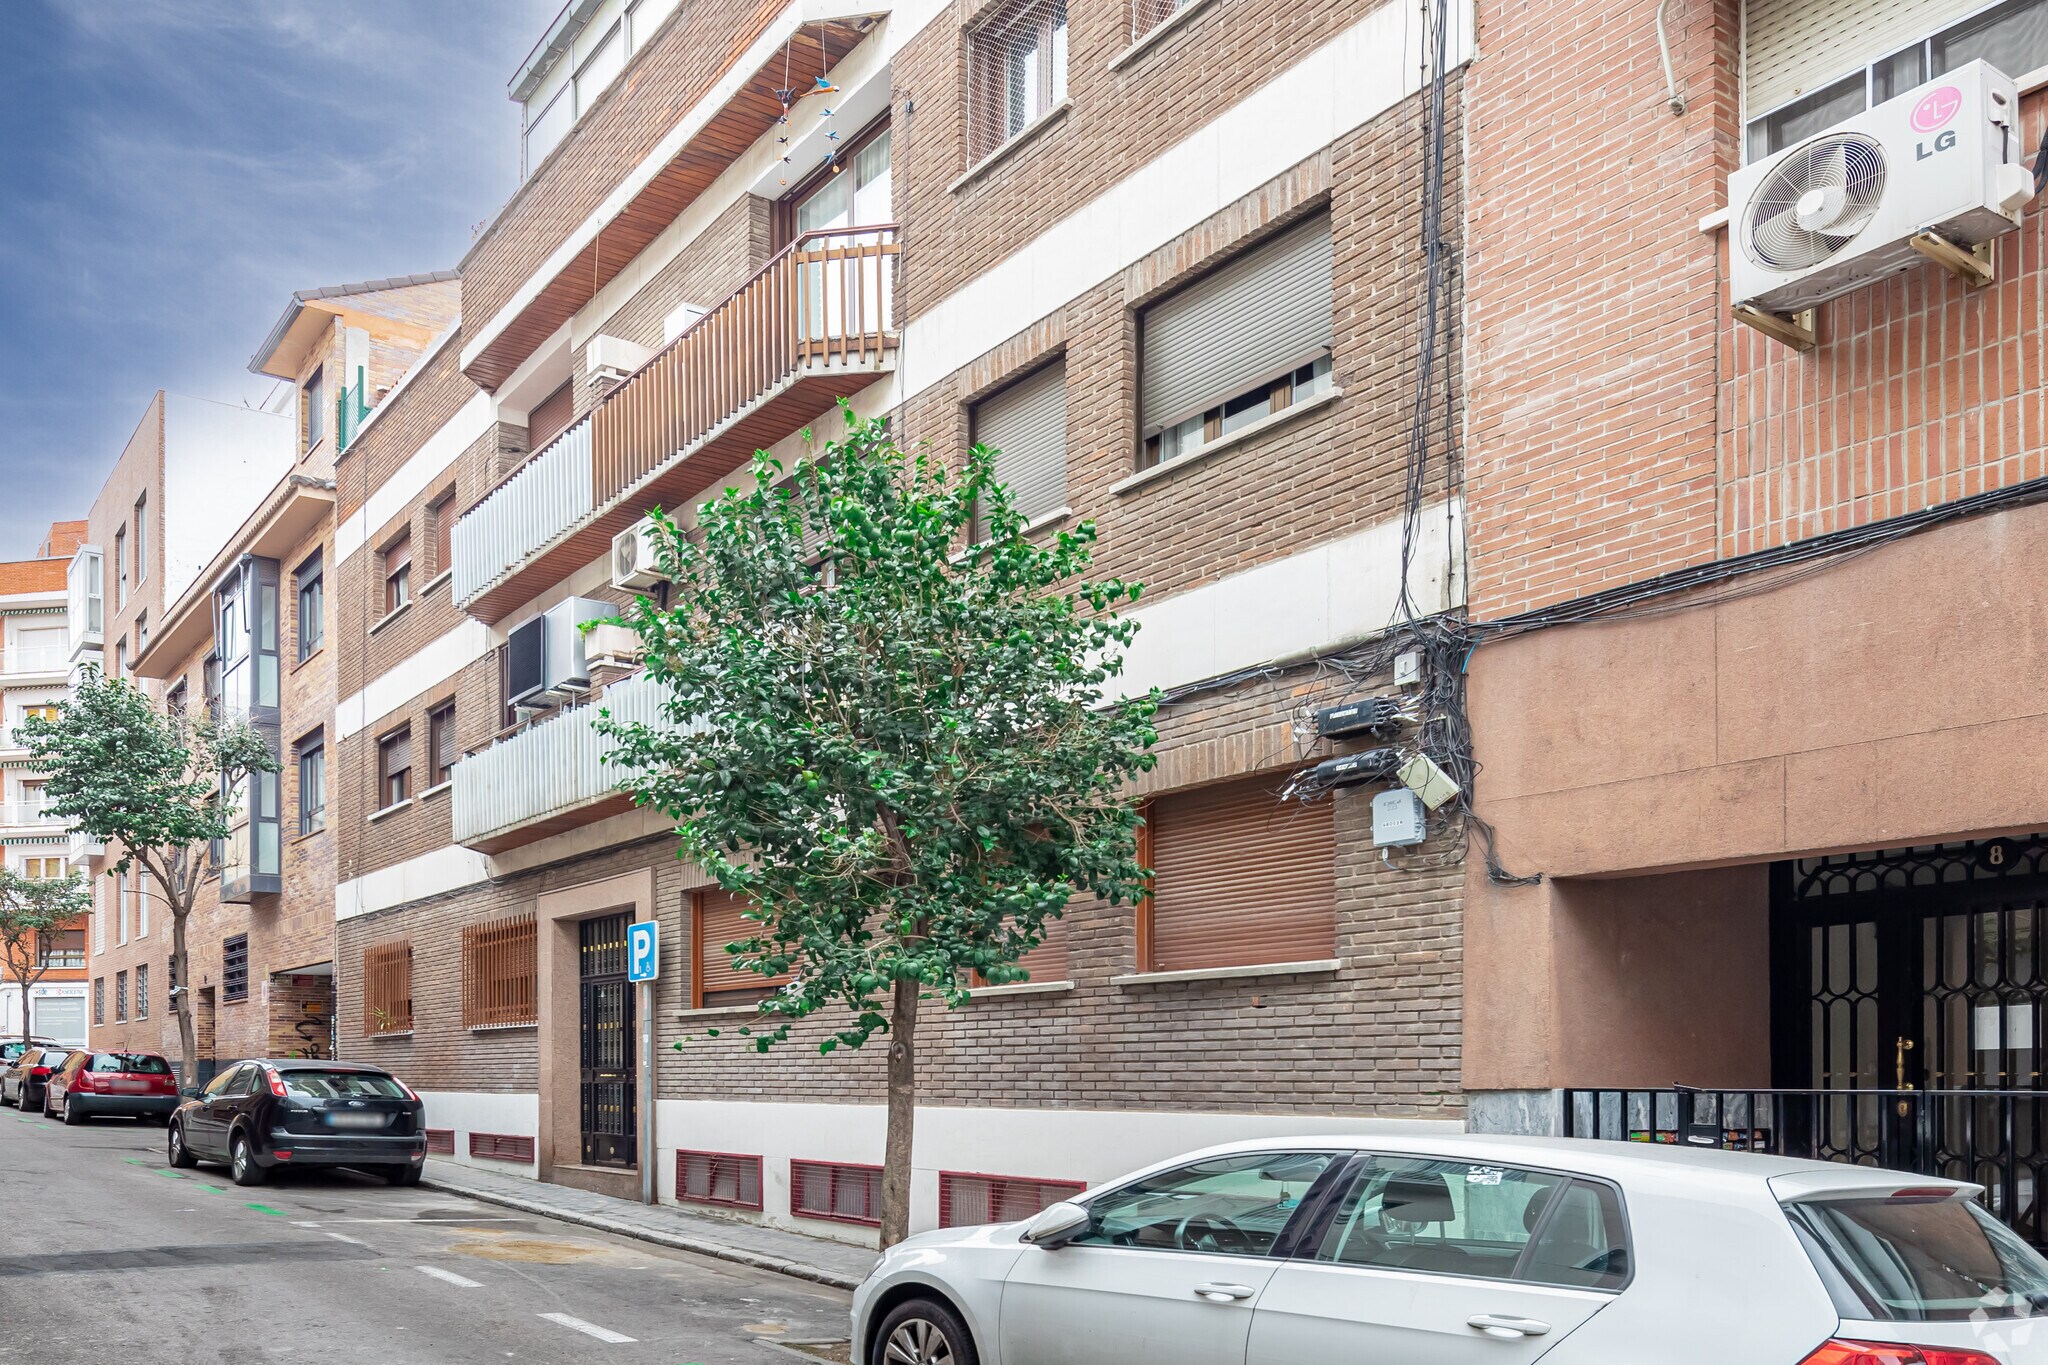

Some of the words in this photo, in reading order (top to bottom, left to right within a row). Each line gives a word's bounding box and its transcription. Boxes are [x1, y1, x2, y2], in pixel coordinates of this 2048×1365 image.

[1916, 130, 1956, 161] LG
[1990, 845, 2003, 864] 8
[633, 930, 650, 974] P
